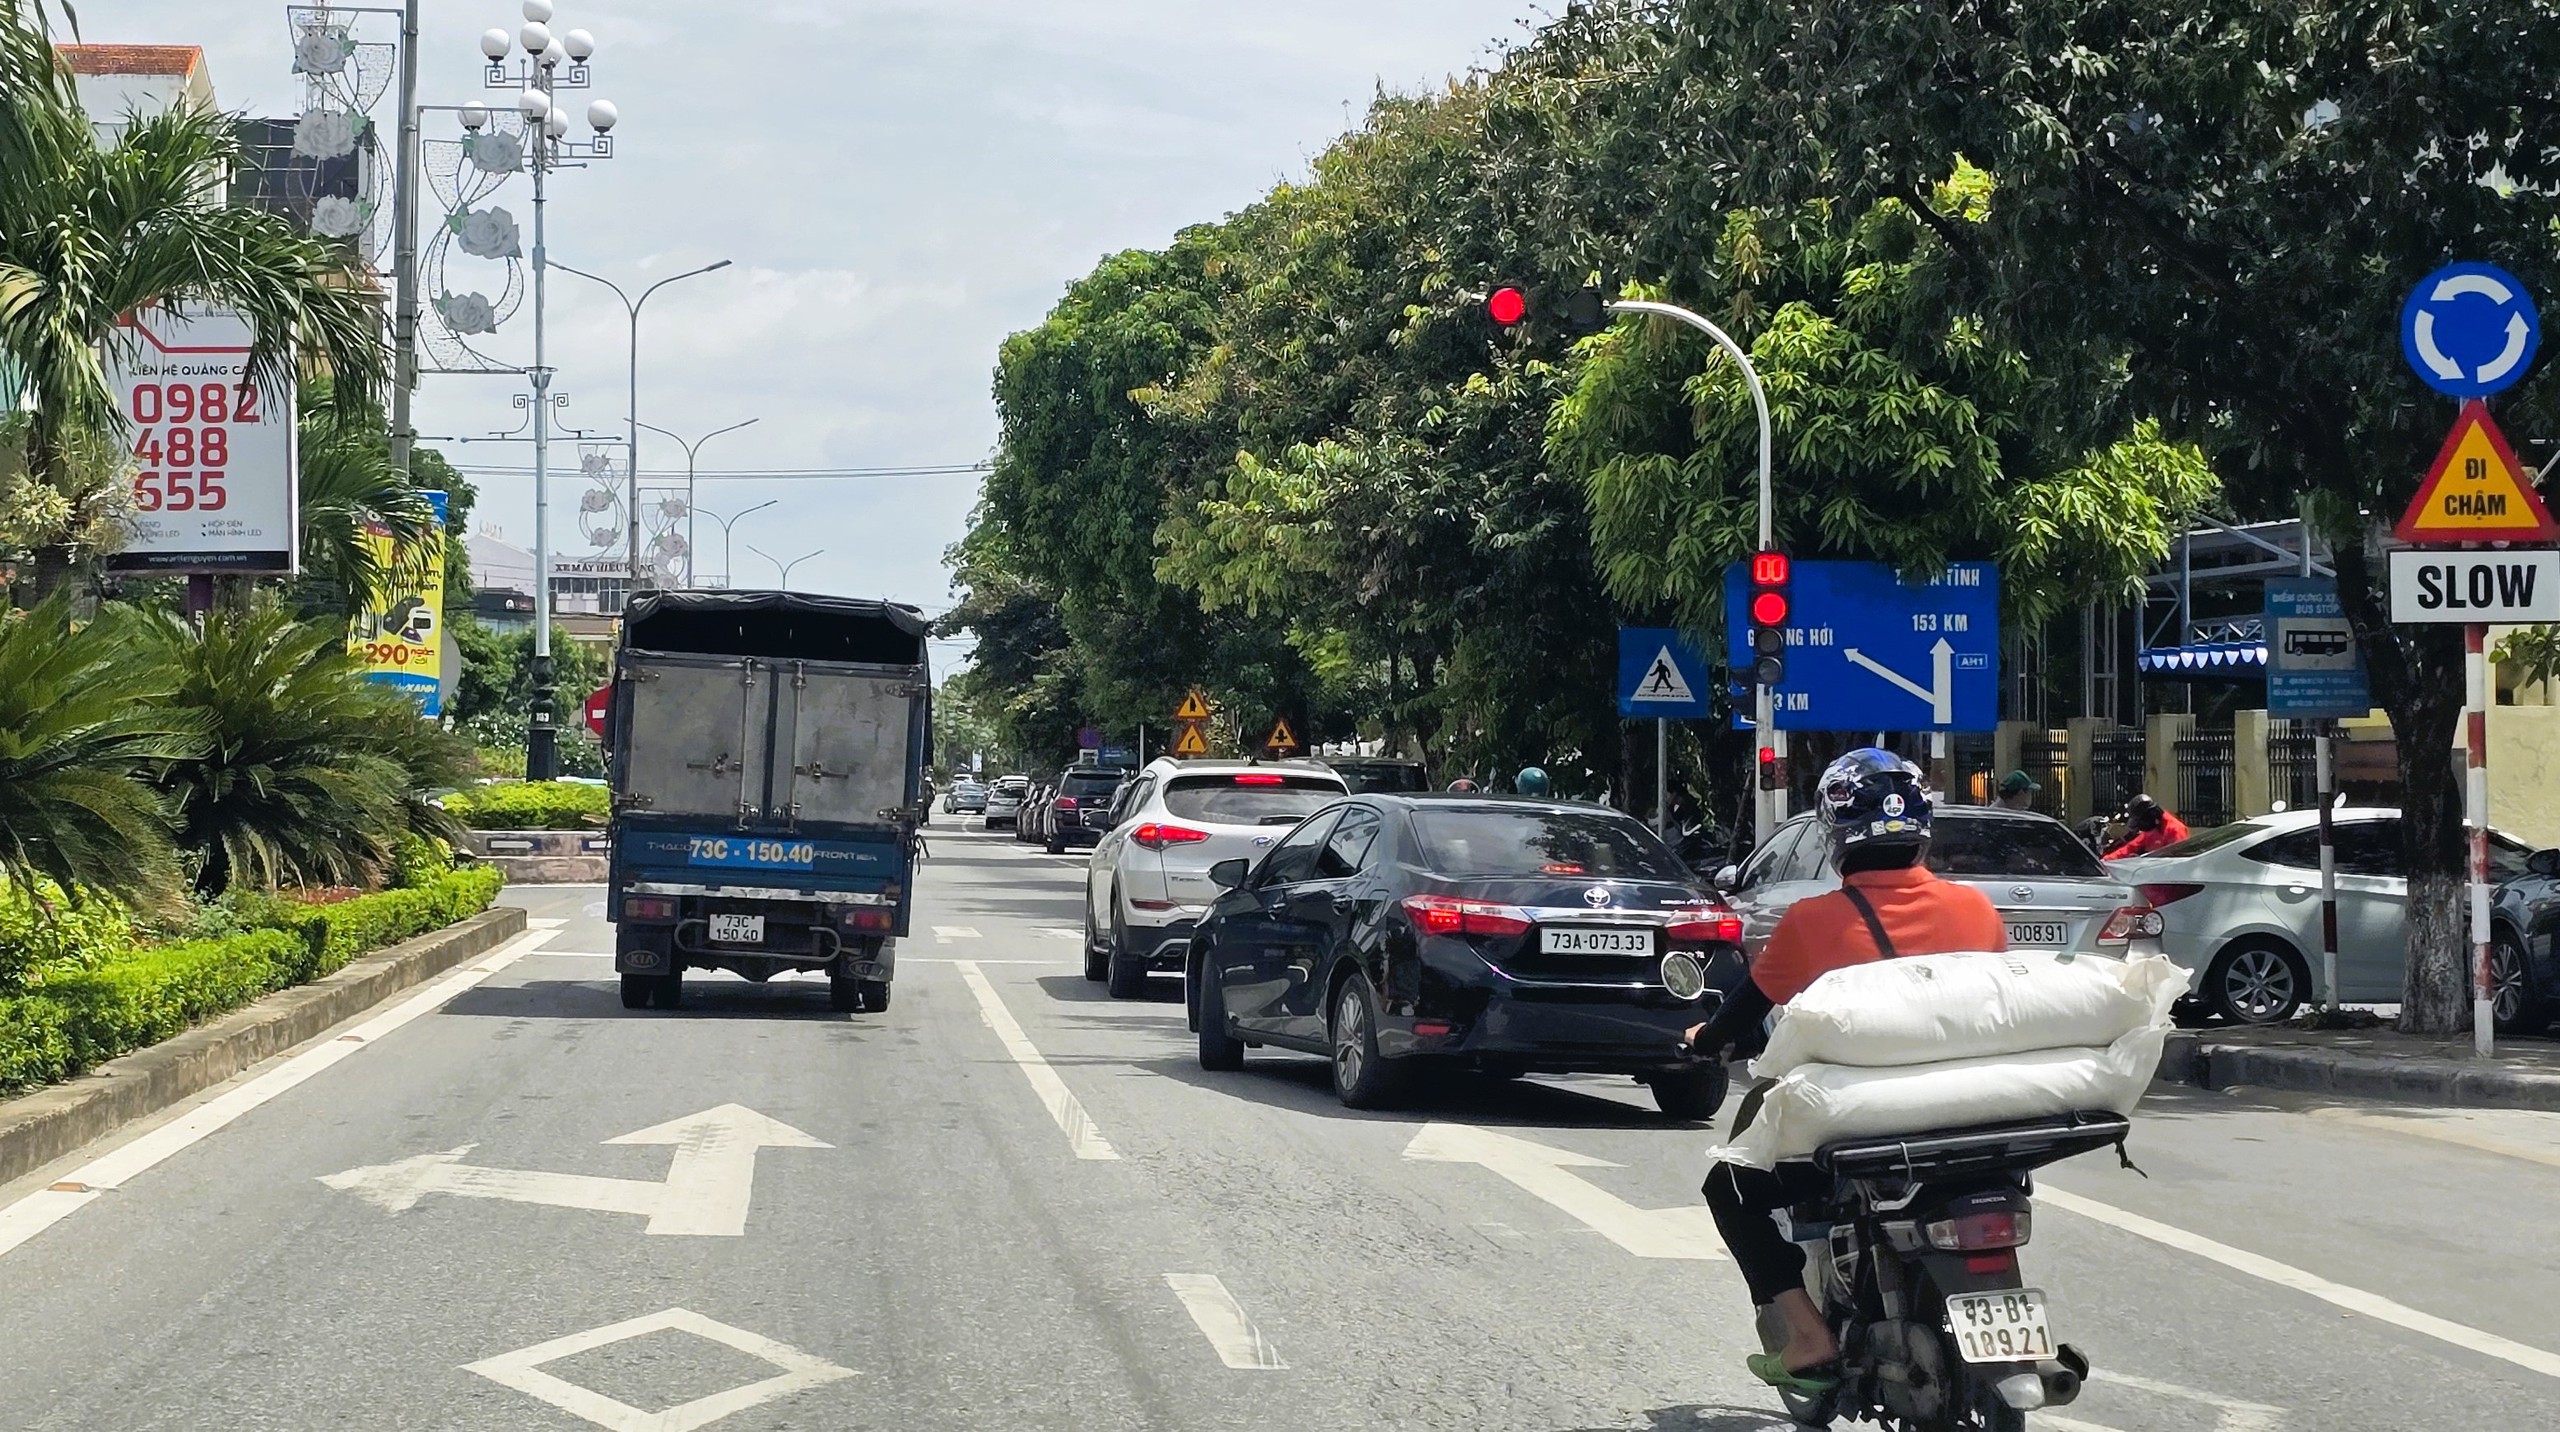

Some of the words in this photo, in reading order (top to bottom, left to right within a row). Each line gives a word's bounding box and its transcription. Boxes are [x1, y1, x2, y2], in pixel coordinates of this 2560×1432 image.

[132, 383, 260, 424] 0982
[133, 427, 228, 468] 488
[2465, 457, 2487, 480] ĐI
[134, 471, 227, 512] 655
[2444, 489, 2507, 521] CHẬM
[2417, 564, 2537, 609] SLOW
[2296, 604, 2314, 614] BUS
[1912, 613, 1937, 632] 153
[1943, 613, 1968, 632] KM
[1809, 622, 1834, 646] HỚI
[364, 643, 409, 665] 290
[1960, 657, 1984, 667] AH1
[1787, 693, 1809, 711] KM
[690, 838, 729, 860] 73C
[747, 841, 814, 864] 150.40
[724, 916, 749, 928] 73C
[715, 928, 759, 942] 150.40
[1551, 932, 1646, 951] 73A-073.33
[2008, 924, 2064, 943] -008.91
[629, 953, 653, 965] KIA
[1962, 1294, 2034, 1327] 73-B1
